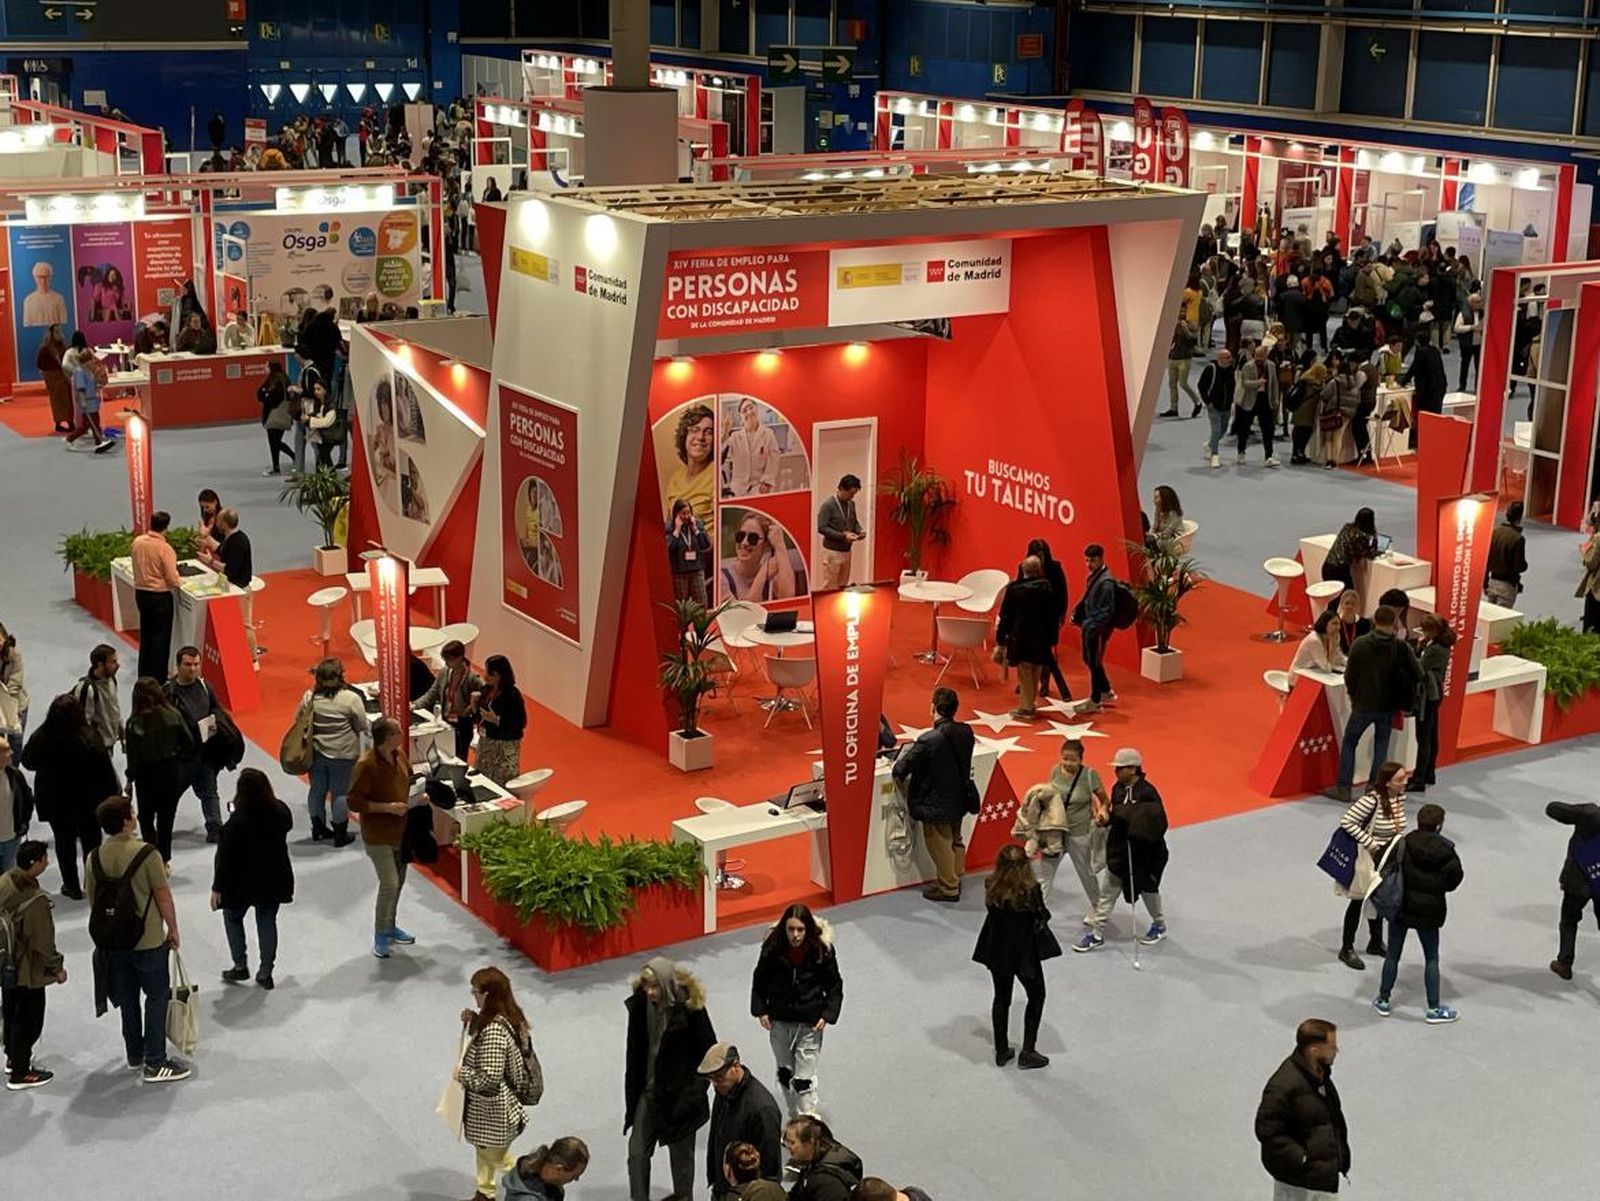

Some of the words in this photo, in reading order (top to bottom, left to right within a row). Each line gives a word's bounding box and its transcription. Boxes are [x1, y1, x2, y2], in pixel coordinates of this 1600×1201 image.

[283, 234, 327, 252] Osga
[673, 260, 689, 270] XIV
[690, 259, 715, 269] FERIA
[716, 257, 728, 267] DE
[731, 255, 765, 267] EMPLEO
[767, 254, 790, 264] PARA
[947, 256, 1002, 270] Comunidad
[588, 269, 627, 289] Comunidad
[667, 269, 799, 301] PERSONAS
[947, 271, 961, 282] de
[964, 268, 1002, 282] Madrid
[588, 285, 598, 298] de
[599, 287, 627, 305] Madrid
[667, 304, 698, 320] CON
[702, 297, 800, 317] DISCAPACIDAD
[510, 413, 565, 451] PERSONAS
[524, 440, 566, 466] DISCAPACIDAD
[988, 459, 1051, 491] BUSCAMOS
[964, 470, 987, 497] TU
[991, 478, 1075, 525] TALENTO
[846, 663, 859, 687] DE
[846, 689, 858, 758] OFICINA
[845, 763, 858, 784] TU
